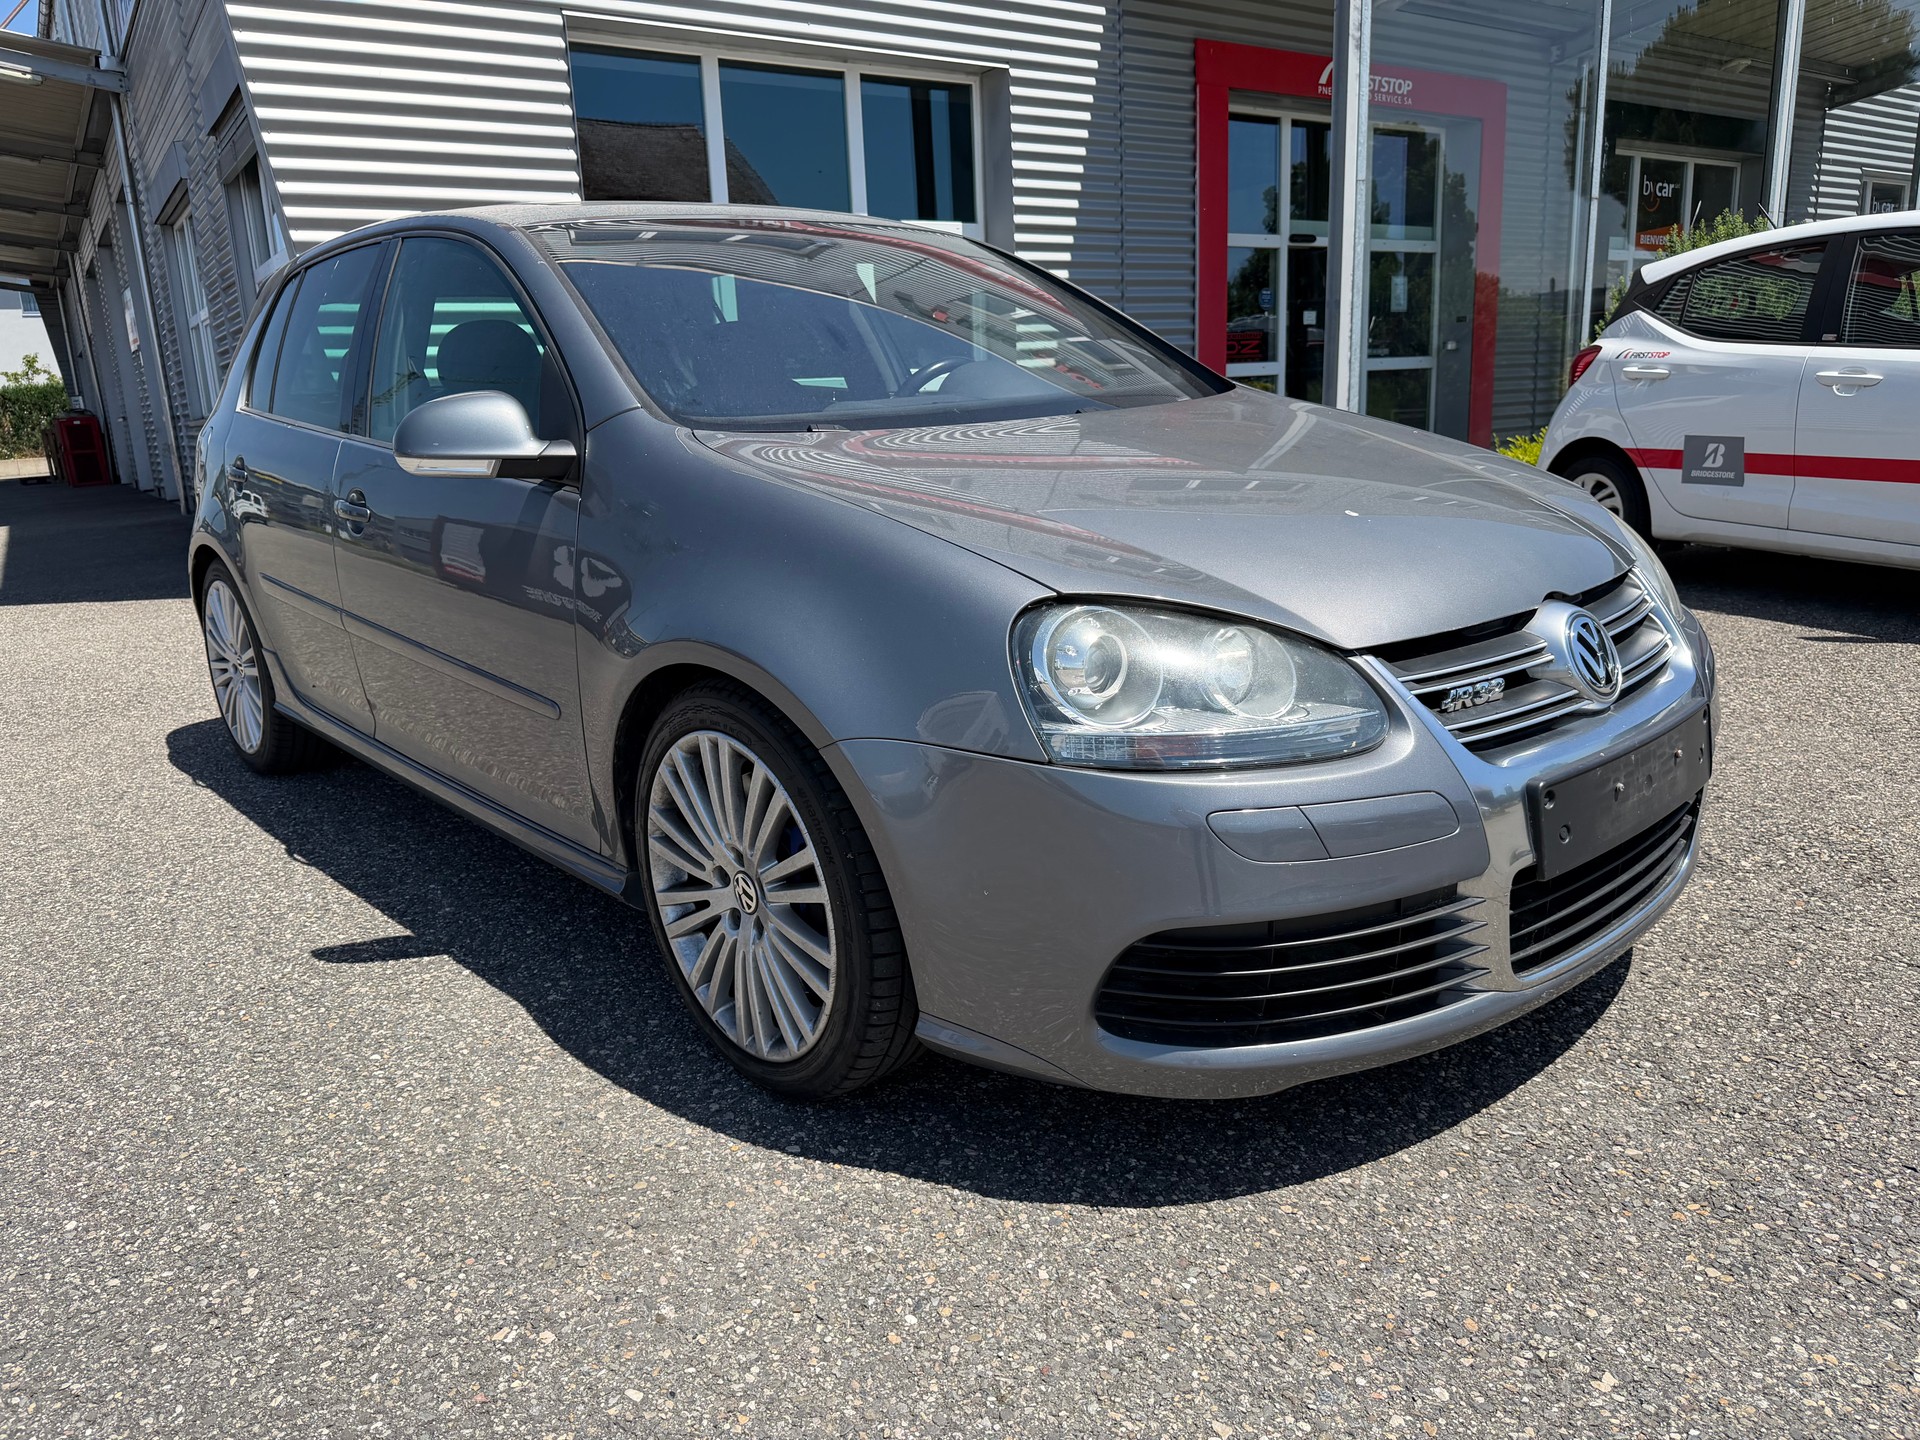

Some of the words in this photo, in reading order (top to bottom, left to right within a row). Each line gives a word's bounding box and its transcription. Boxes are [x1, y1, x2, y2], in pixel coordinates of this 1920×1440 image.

[1317, 85, 1333, 96] PNE
[1374, 93, 1402, 104] SERVICE
[1404, 97, 1413, 105] SA
[1368, 75, 1413, 95] STSTOP
[1690, 470, 1736, 479] BRIDGESTONE
